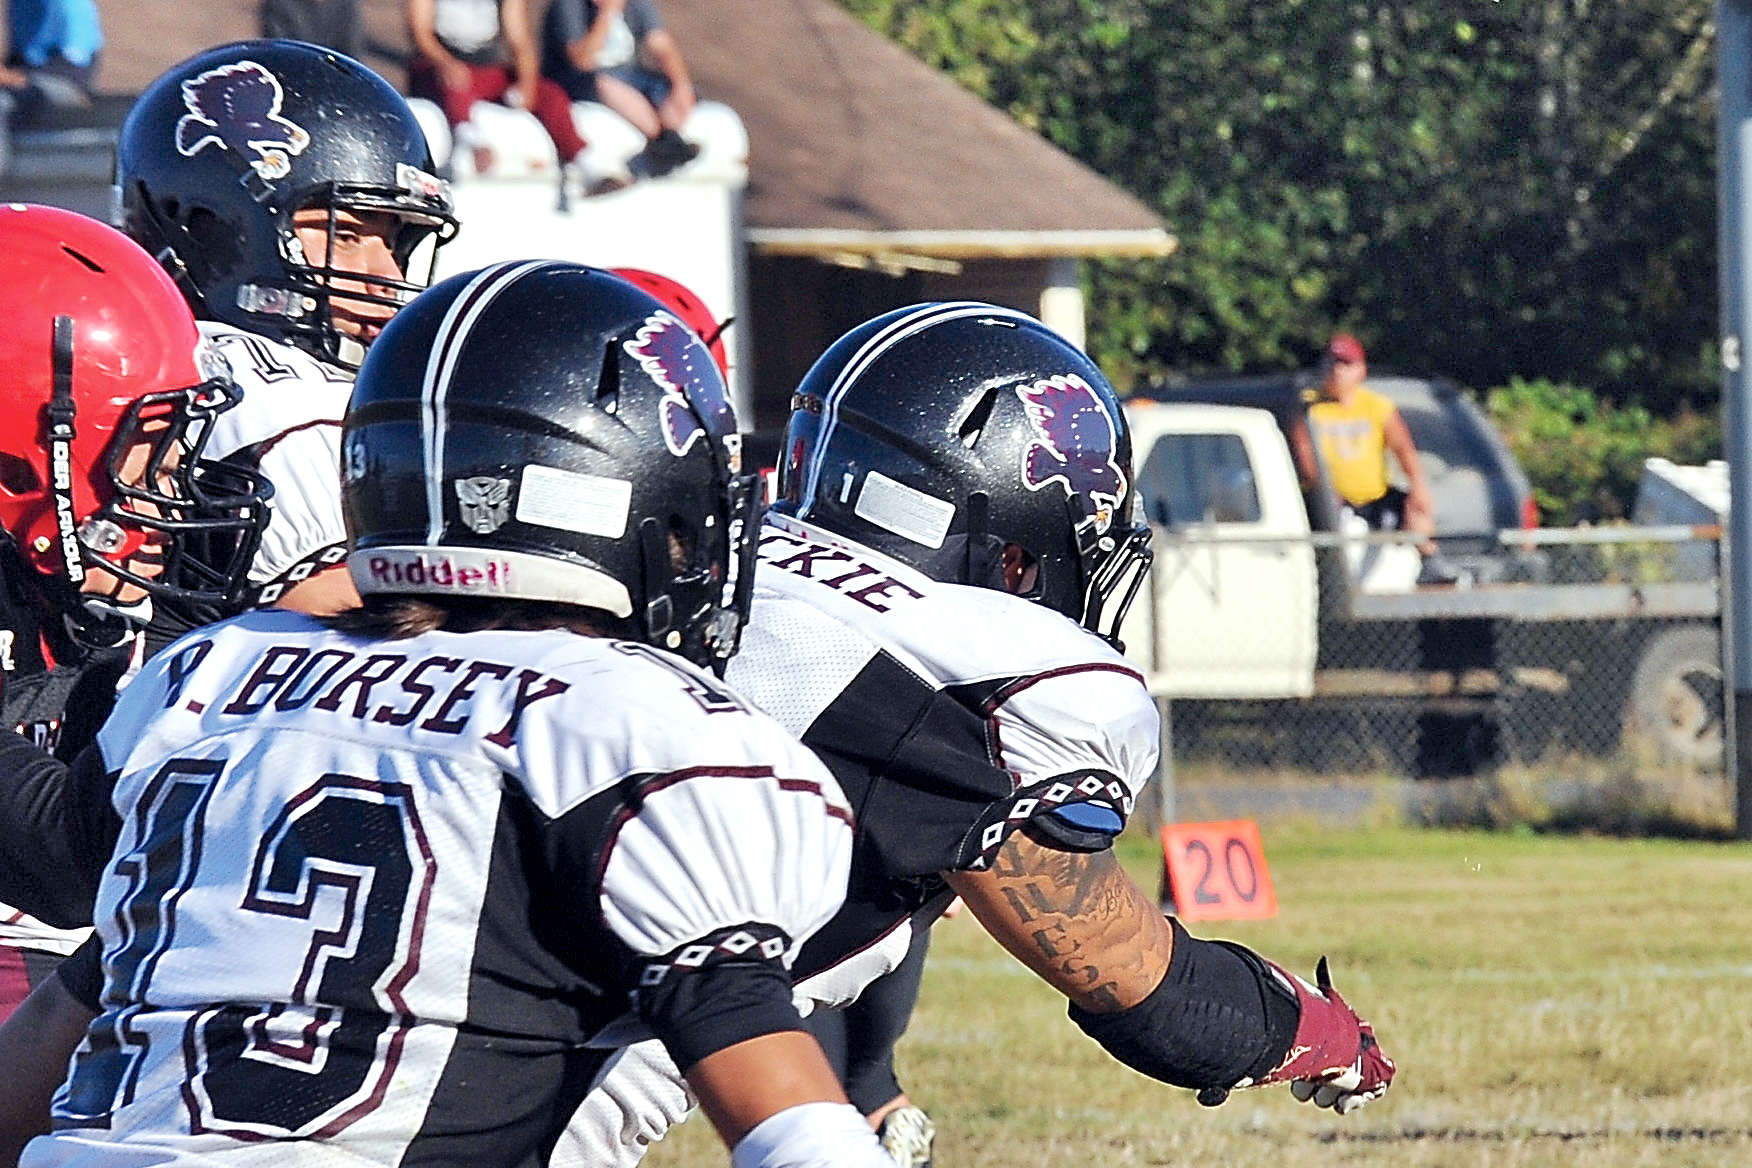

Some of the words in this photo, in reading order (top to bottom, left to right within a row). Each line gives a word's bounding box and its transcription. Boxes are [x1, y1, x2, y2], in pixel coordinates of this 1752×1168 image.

[369, 554, 512, 589] Riddell
[222, 645, 571, 749] BORSEY
[1185, 838, 1258, 906] 20
[50, 757, 438, 1144] 13
